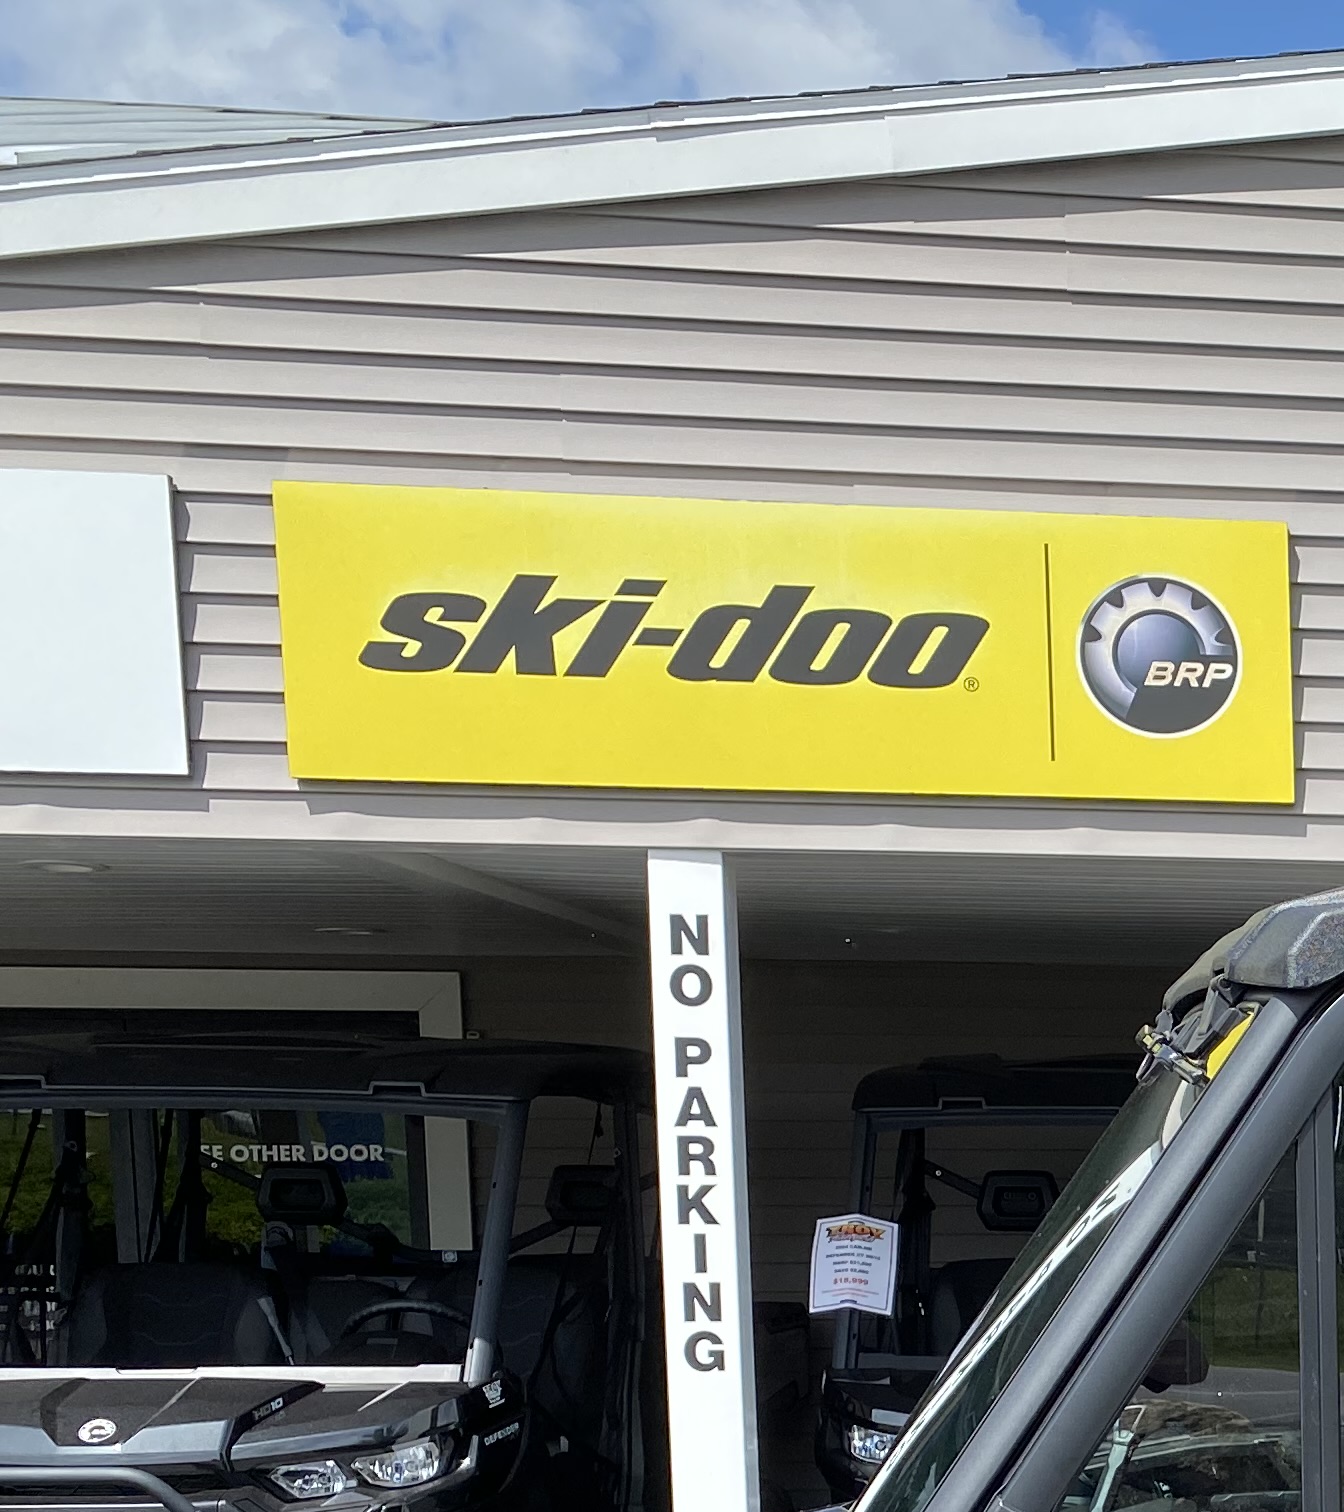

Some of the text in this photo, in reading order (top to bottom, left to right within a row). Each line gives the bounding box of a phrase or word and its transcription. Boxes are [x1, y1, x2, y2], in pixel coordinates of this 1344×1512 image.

[358, 573, 991, 691] ski-doo
[1144, 660, 1233, 690] BRP
[229, 1144, 307, 1163] OTHER
[312, 1143, 385, 1163] DOOR
[669, 913, 726, 1372] NO PARKING
[252, 1397, 284, 1420] HD10
